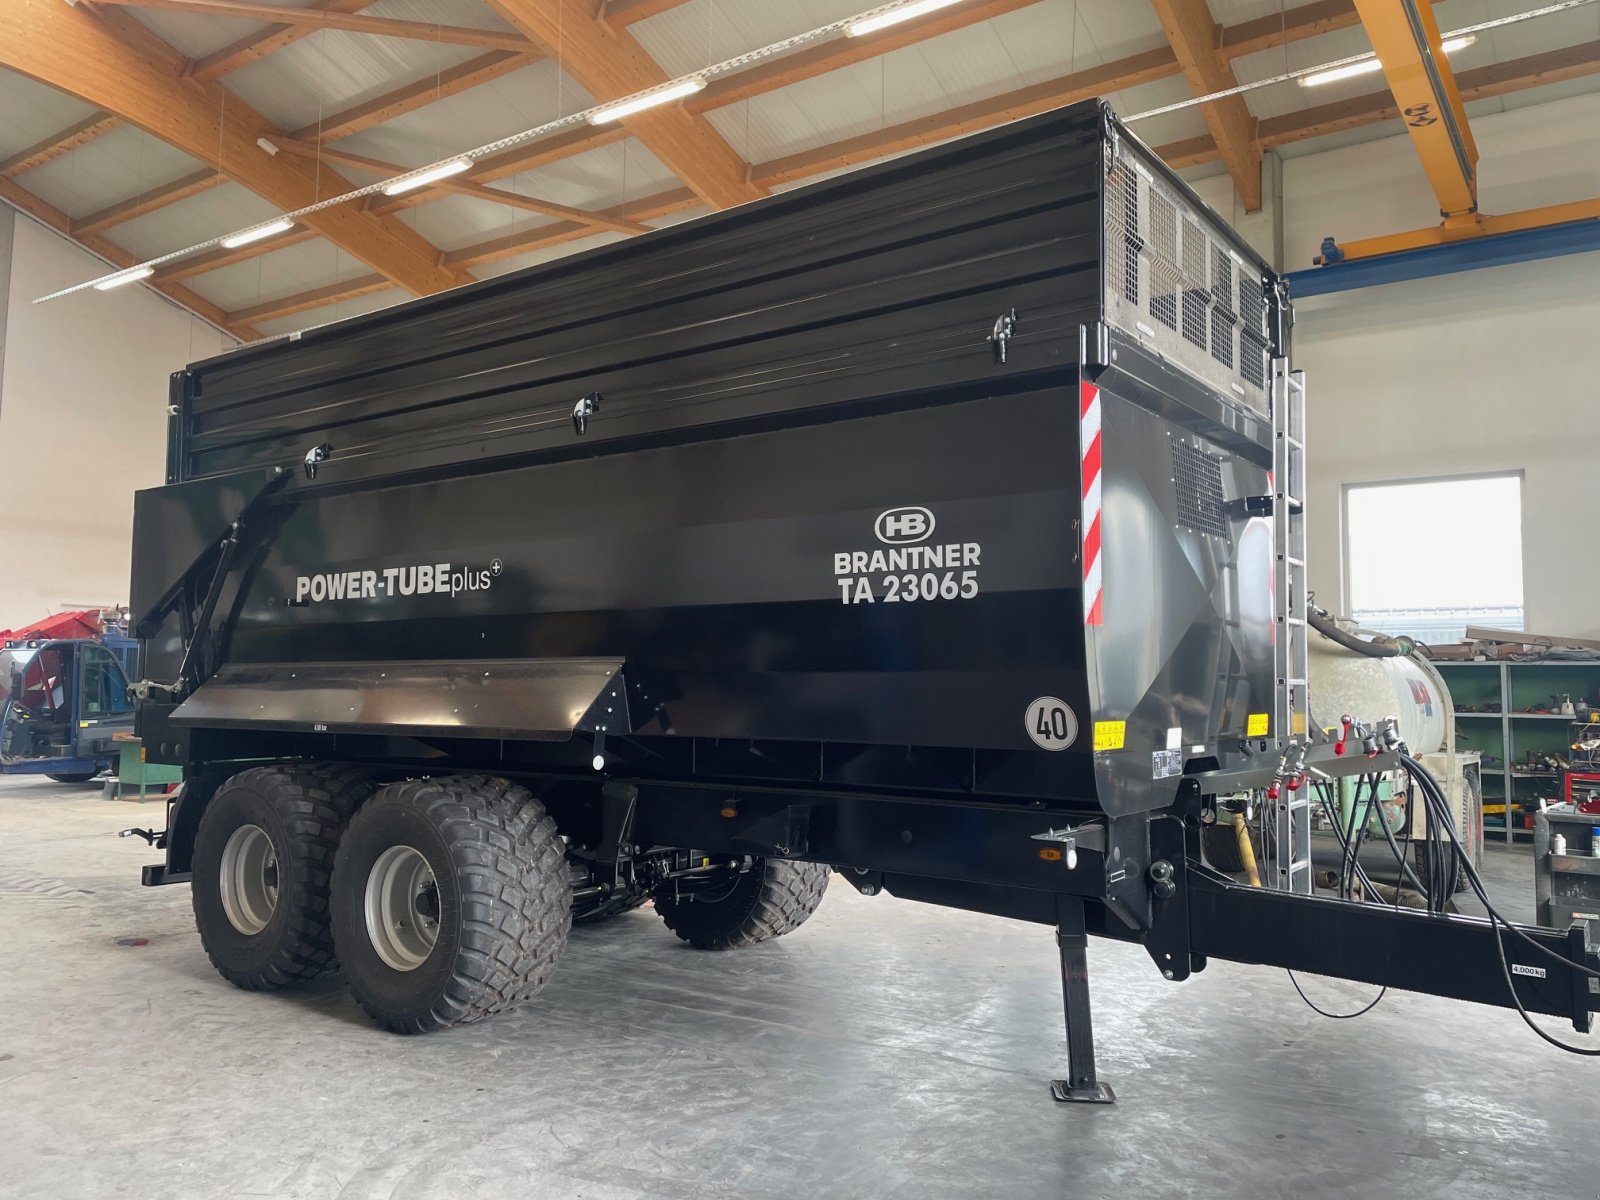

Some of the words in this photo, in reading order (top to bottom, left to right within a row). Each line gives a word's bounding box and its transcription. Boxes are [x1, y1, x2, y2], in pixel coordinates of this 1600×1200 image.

[886, 513, 926, 537] HB
[834, 542, 981, 575] BRANTNER
[837, 576, 875, 605] TA
[883, 570, 979, 603] 23065
[1036, 706, 1068, 740] 40
